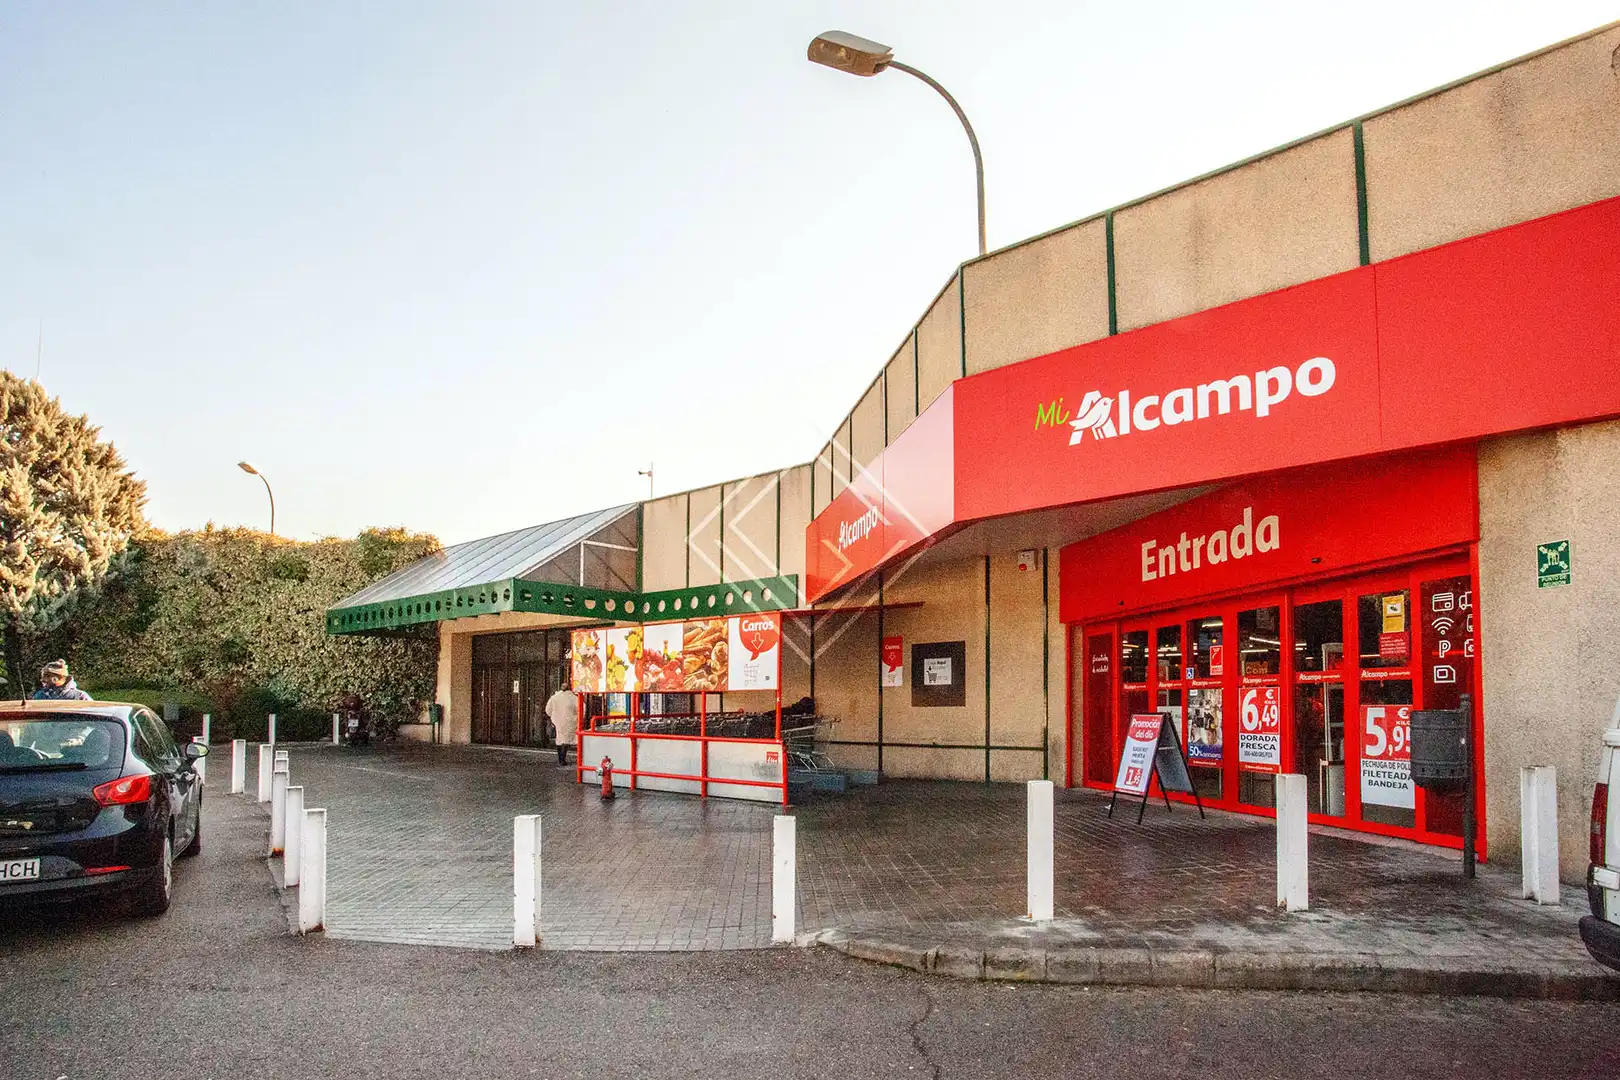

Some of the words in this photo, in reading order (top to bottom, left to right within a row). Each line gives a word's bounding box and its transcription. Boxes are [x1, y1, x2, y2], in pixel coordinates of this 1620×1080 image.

[1034, 398, 1070, 431] Mi
[1069, 357, 1336, 446] Alcampo
[838, 505, 878, 552] Alcampo
[1141, 506, 1280, 582] Entrada
[742, 620, 774, 632] Carros
[1299, 673, 1321, 681] Alcampo
[1361, 669, 1388, 679] Alcampo
[1131, 718, 1160, 729] Promoción
[1240, 734, 1278, 742] DORADA
[1240, 742, 1276, 751] FRESCA
[1362, 760, 1388, 769] PECHUGA
[1388, 761, 1396, 769] DE
[1396, 762, 1411, 771] POLL
[1362, 769, 1412, 780] FILETEADA
[1368, 779, 1408, 790] BANDEJA
